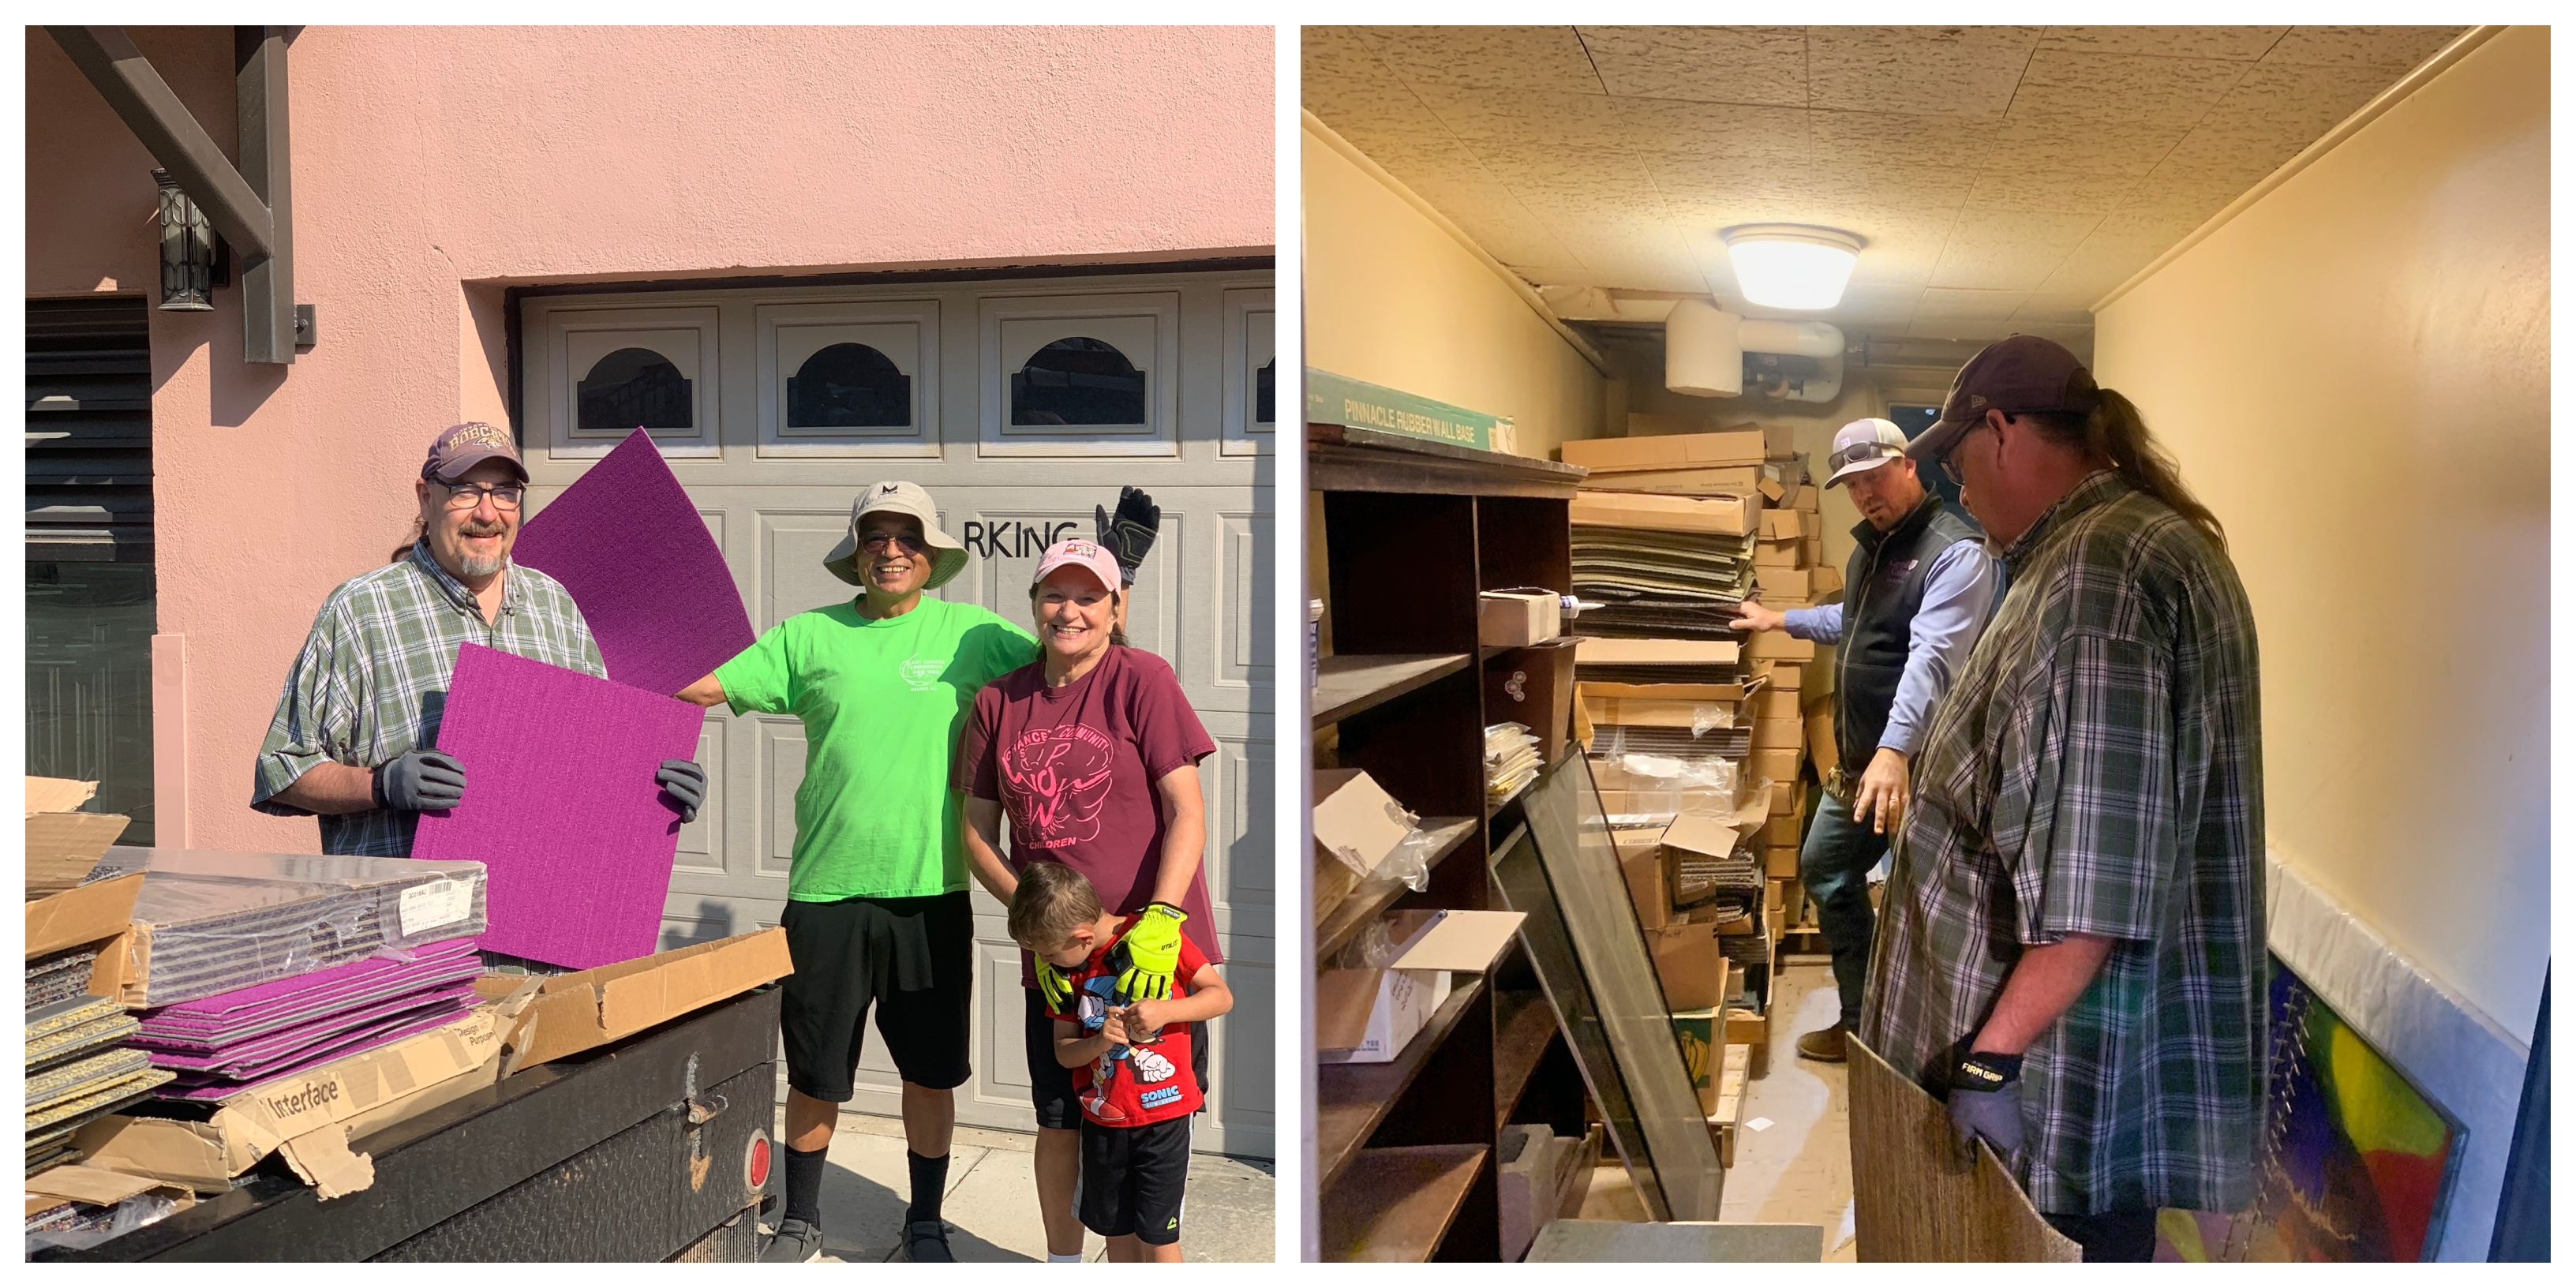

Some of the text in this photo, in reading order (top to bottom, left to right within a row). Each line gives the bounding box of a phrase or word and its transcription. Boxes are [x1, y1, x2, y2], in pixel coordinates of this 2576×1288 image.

[1345, 399, 1395, 429] PINNACLE
[1397, 410, 1432, 435] RUBBER
[1432, 418, 1455, 439] WALL
[1456, 424, 1475, 443] BASE
[1029, 837, 1076, 849] CHILDREN
[469, 1032, 494, 1046] Purpose
[1962, 1062, 2003, 1082] FIRM GRIP
[268, 1081, 338, 1119] Interface
[1140, 1084, 1180, 1103] SONIC
